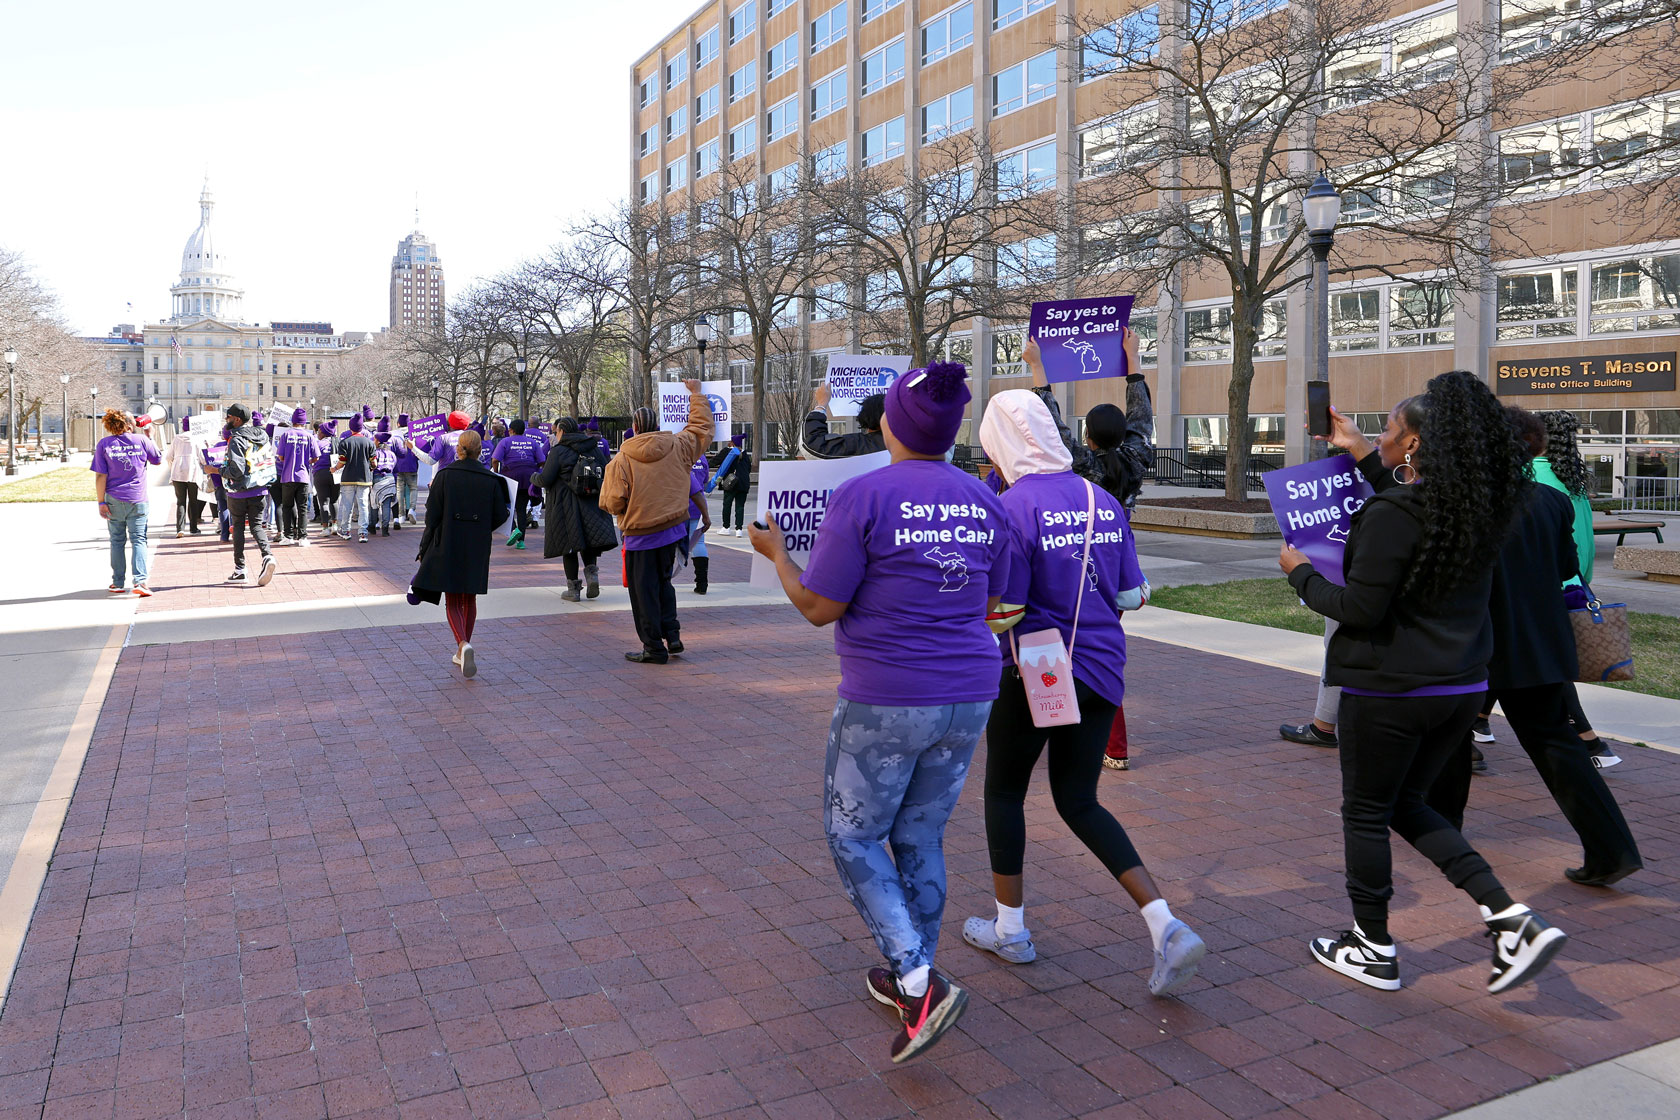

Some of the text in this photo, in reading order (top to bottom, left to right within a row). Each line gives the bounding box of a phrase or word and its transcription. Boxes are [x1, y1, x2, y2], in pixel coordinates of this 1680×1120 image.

[1046, 305, 1116, 322] Say yes to
[1038, 319, 1119, 338] Home Care!
[830, 366, 880, 376] MICHIGAN
[1499, 360, 1672, 378] Stevens T. Mason
[830, 377, 878, 387] HOME CARE
[1531, 379, 1633, 389] State Office Building
[663, 404, 685, 413] HOME
[1600, 455, 1612, 463] B1
[1286, 480, 1318, 500] Say
[1321, 472, 1352, 497] yes
[900, 501, 987, 521] Say yes to
[1042, 510, 1071, 526] Say
[1097, 508, 1115, 521] to
[1287, 505, 1341, 530] Home
[895, 528, 952, 546] Home
[1040, 700, 1065, 711] Milk
